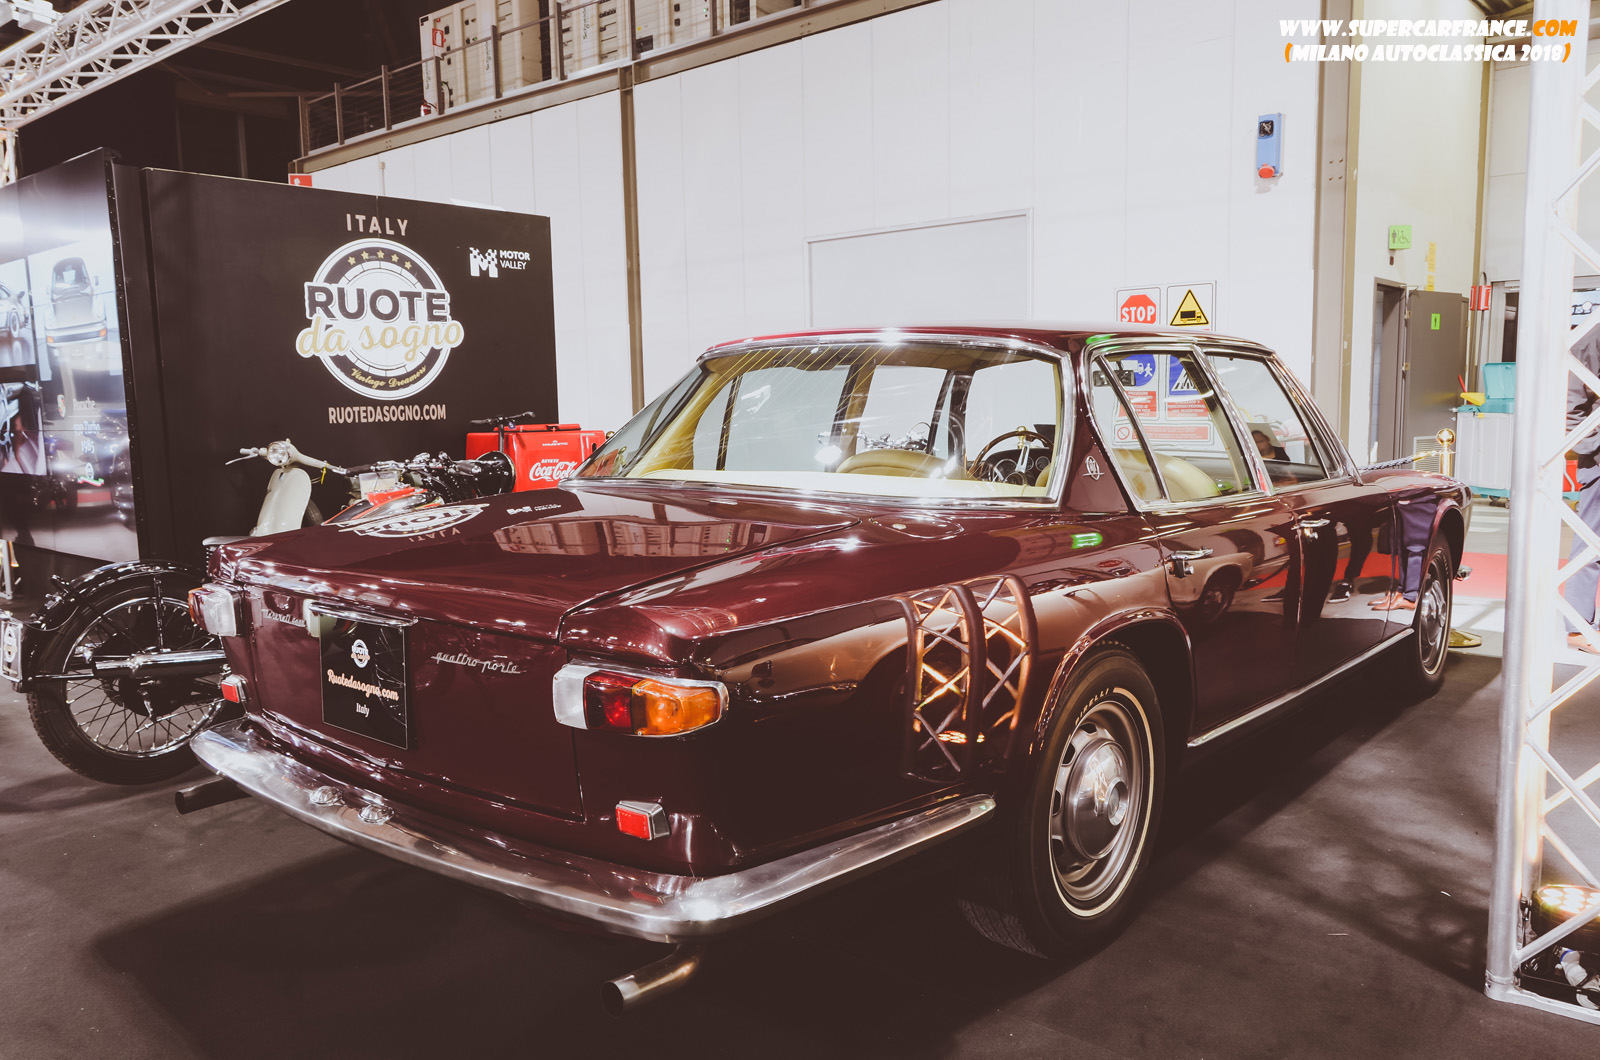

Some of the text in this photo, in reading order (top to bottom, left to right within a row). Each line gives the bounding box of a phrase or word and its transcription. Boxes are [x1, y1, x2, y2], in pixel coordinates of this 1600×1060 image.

[346, 213, 408, 237] ITALY
[500, 249, 530, 261] MOTOR
[500, 259, 527, 270] VALLEY
[306, 284, 449, 323] RUOTE
[1121, 305, 1156, 322] STOP
[299, 315, 462, 362] da sogno
[350, 364, 427, 389] Vintage Dreamers
[328, 403, 447, 424] RUOTEDASOGNO.COM
[431, 652, 522, 674] quattro porte
[327, 668, 400, 701] Ruotedasogno.com
[355, 702, 370, 718] Italy
[1074, 687, 1110, 727] PIRELLI
